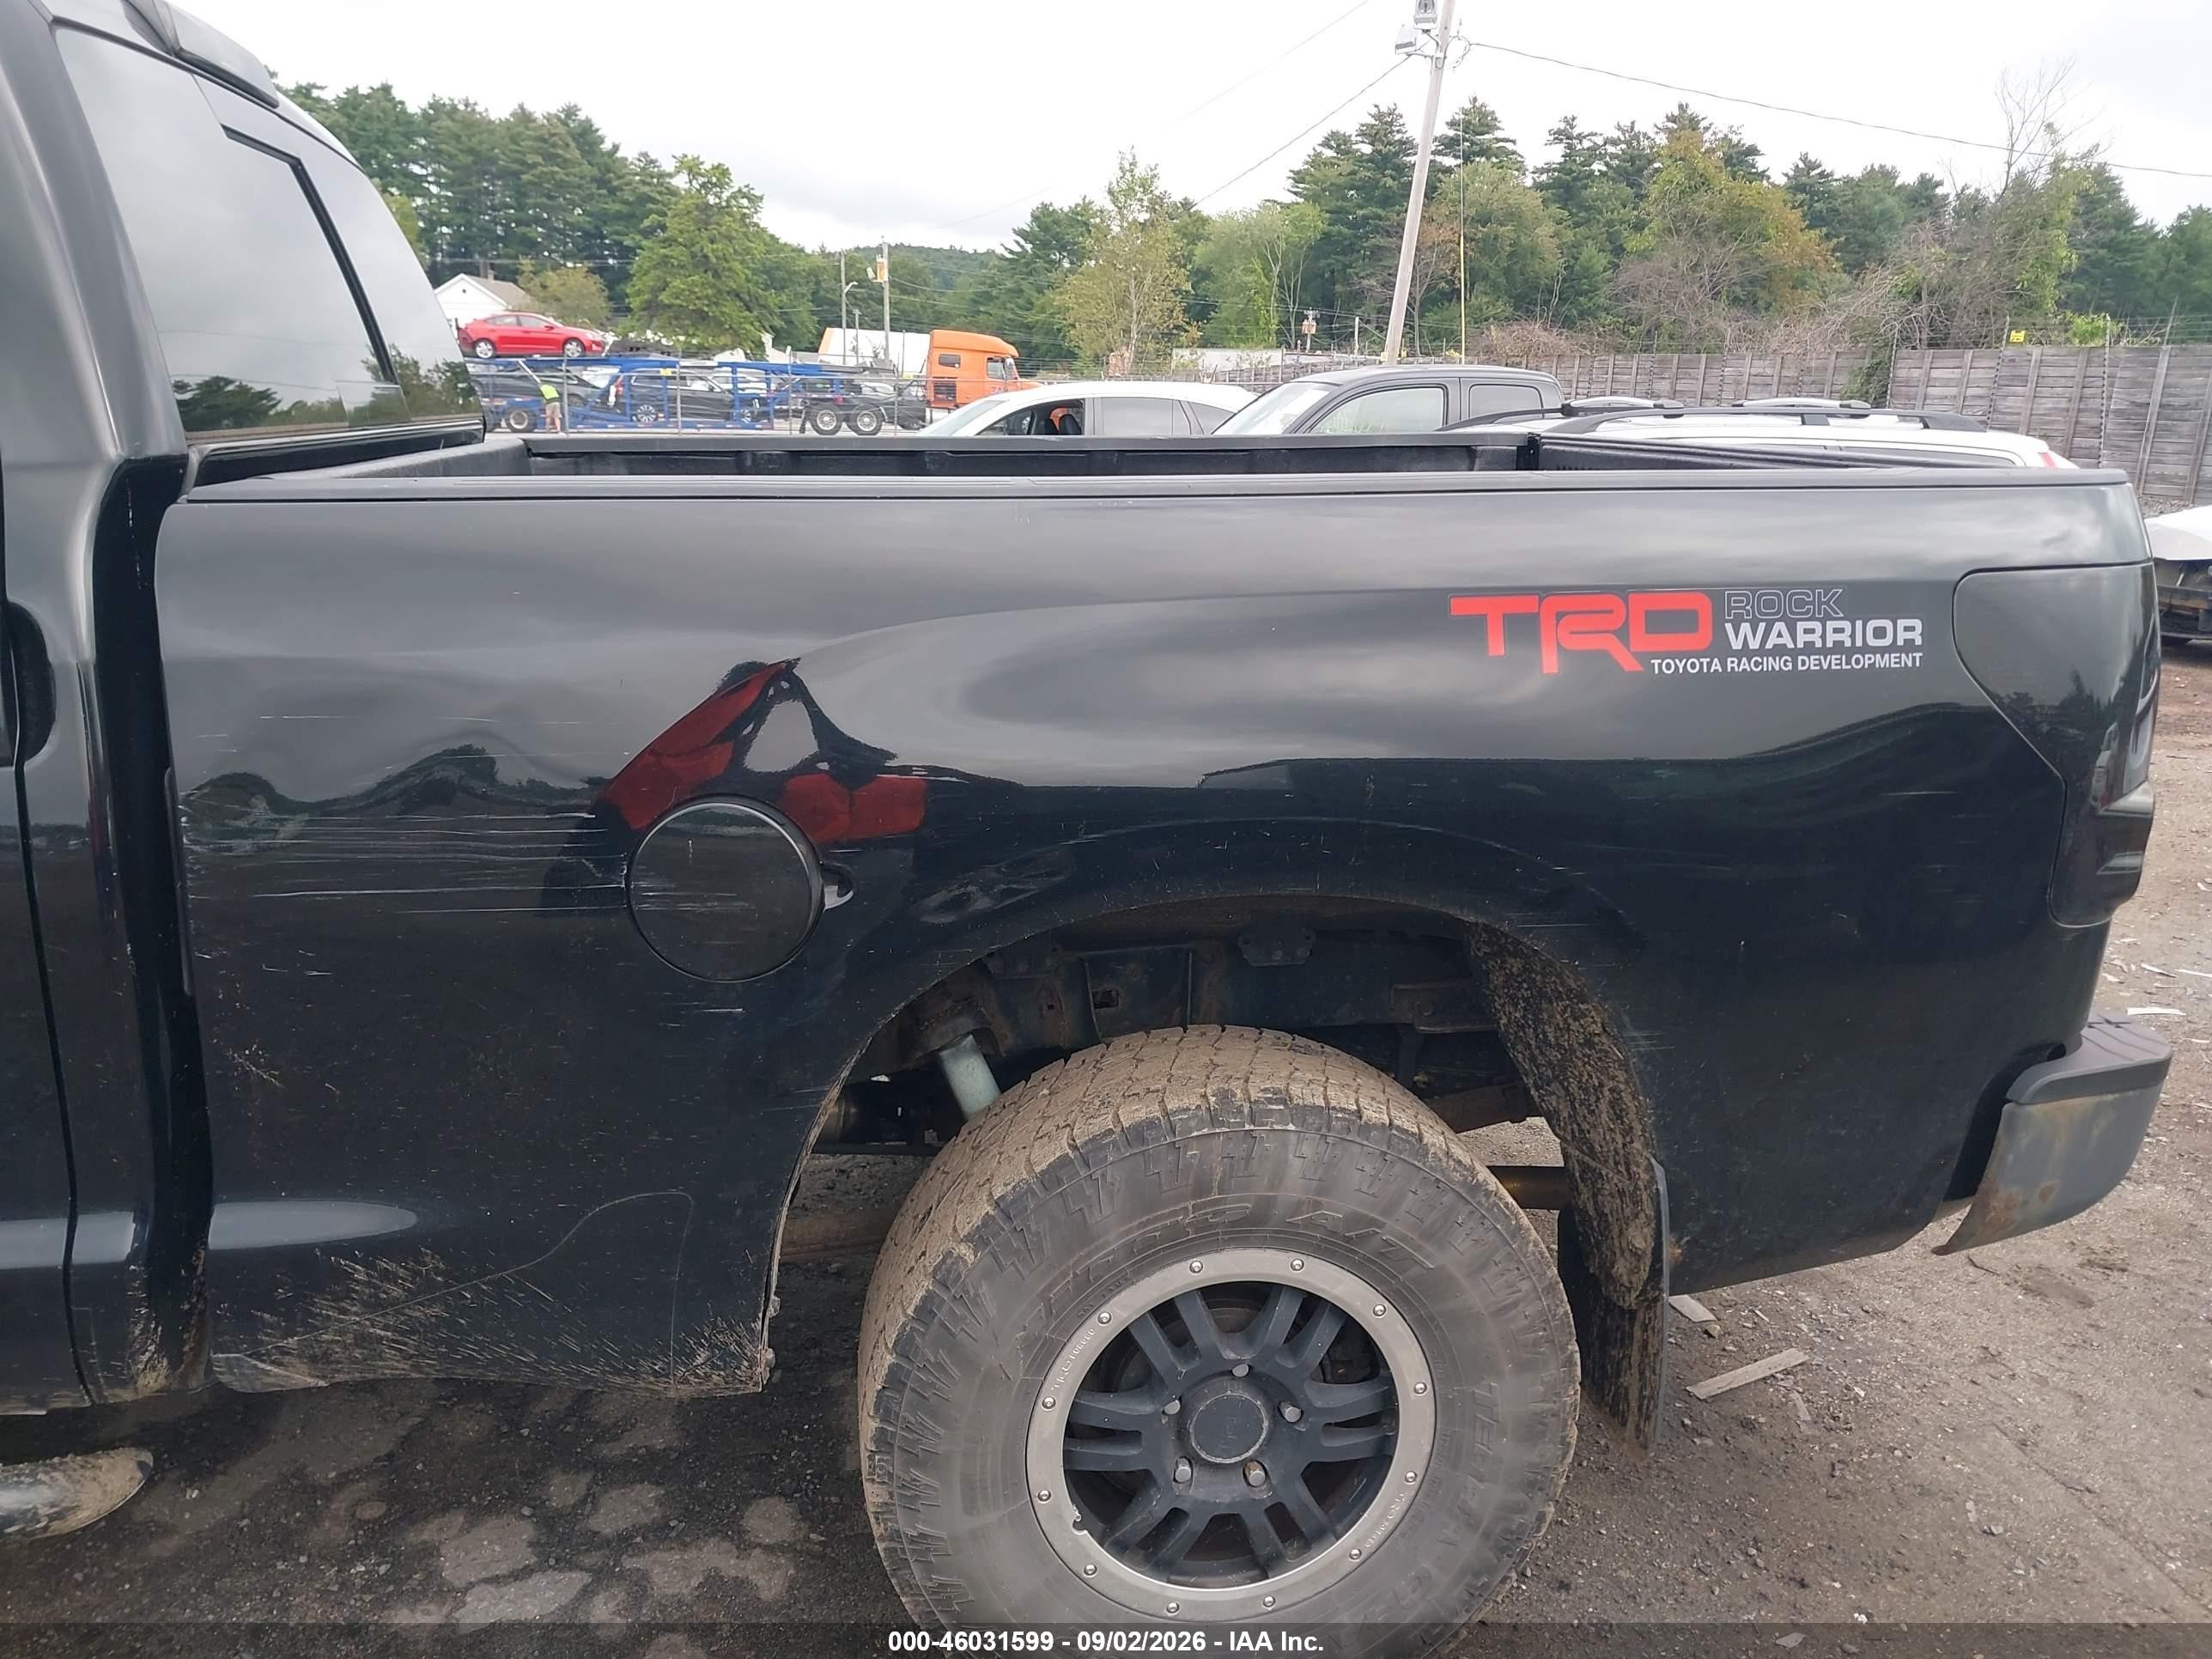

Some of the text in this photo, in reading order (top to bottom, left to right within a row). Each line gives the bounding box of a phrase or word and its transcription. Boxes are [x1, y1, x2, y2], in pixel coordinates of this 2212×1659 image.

[1723, 588, 1844, 619] ROCK
[1449, 592, 1713, 674] TRD
[1723, 618, 1923, 650] WARRIOR
[1650, 653, 1923, 675] TOYOTA RACING DEVELOPMENT
